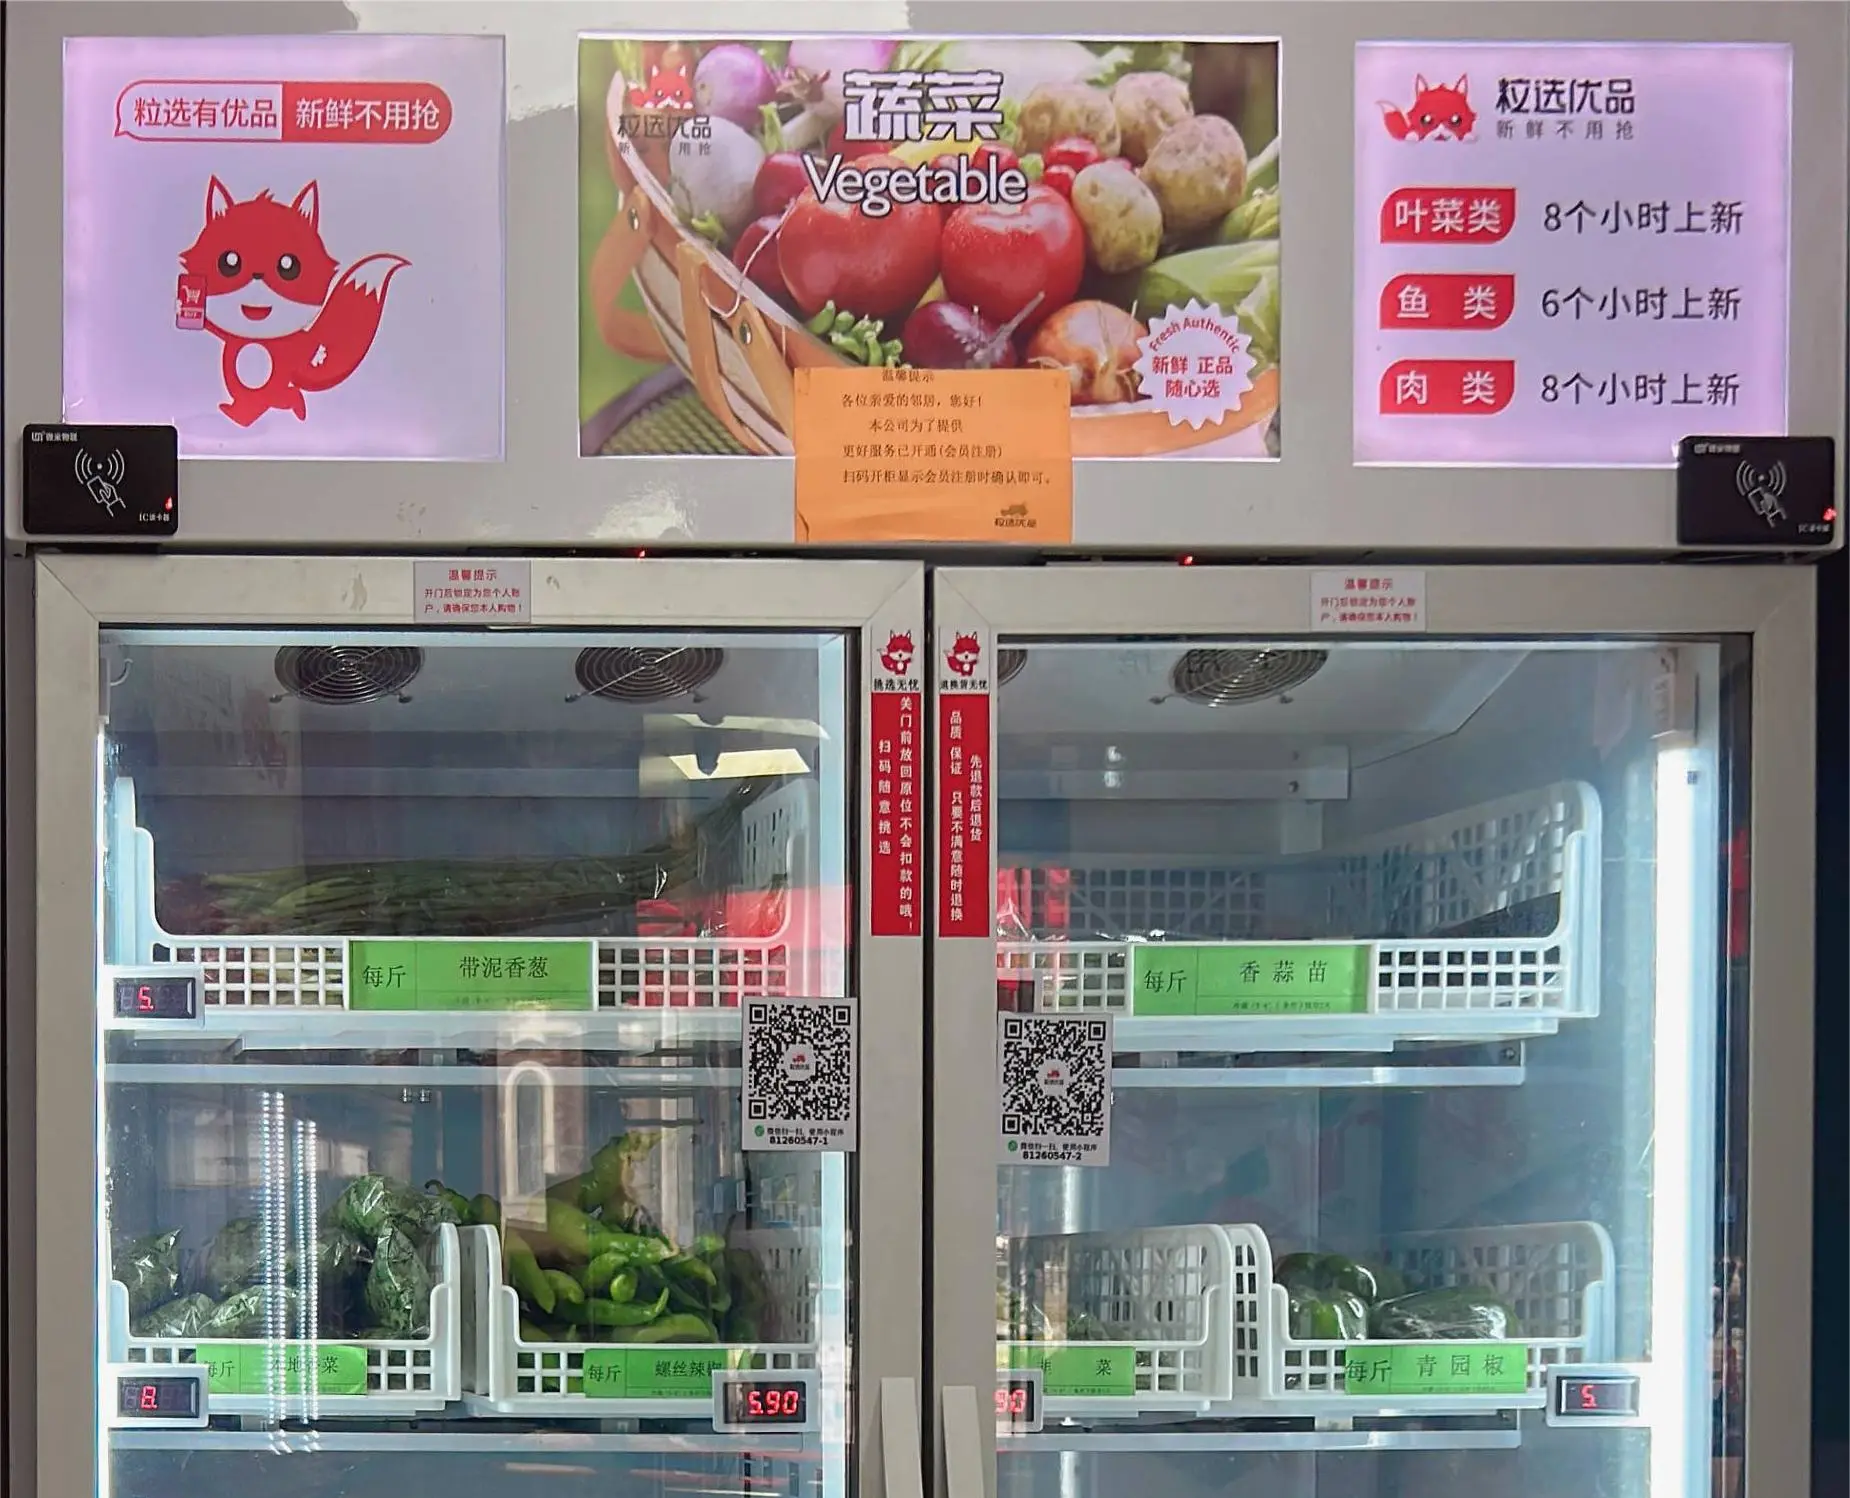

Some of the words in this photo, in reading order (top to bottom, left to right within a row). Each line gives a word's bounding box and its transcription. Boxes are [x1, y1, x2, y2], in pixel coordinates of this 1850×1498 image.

[843, 69, 1004, 141] 蔬菜
[1495, 78, 1636, 114] 粒选优品
[134, 97, 278, 129] 粒选有优品
[296, 98, 440, 130] 新鲜不用抢
[1496, 120, 1635, 139] 新鲜不用抢
[619, 142, 711, 156] 新用抢
[801, 153, 1028, 217] Vegetable
[1395, 198, 1502, 234] 叶菜类
[1544, 200, 1745, 235] 8个小时上新
[1542, 287, 1741, 320] 6个小时上新
[1149, 322, 1181, 352] Fresh
[1183, 318, 1240, 353] Authentic
[1152, 356, 1188, 374] 新鲜
[1198, 356, 1233, 374] 正品
[1165, 379, 1220, 398] 随心选
[1541, 372, 1740, 405] 8个小时上新
[869, 418, 963, 433] 本公司为了提供
[879, 739, 891, 855] 扫码随意挑选
[363, 964, 407, 988] 每斤
[459, 956, 549, 979] 带泥香葱
[1144, 969, 1188, 993] 每斤
[1239, 960, 1328, 984] 香蒜苗
[1022, 1151, 1082, 1161] 81260547-2
[587, 1364, 622, 1383] 每斤
[1345, 1359, 1393, 1383] 每斤
[1416, 1353, 1506, 1378] 青园椒
